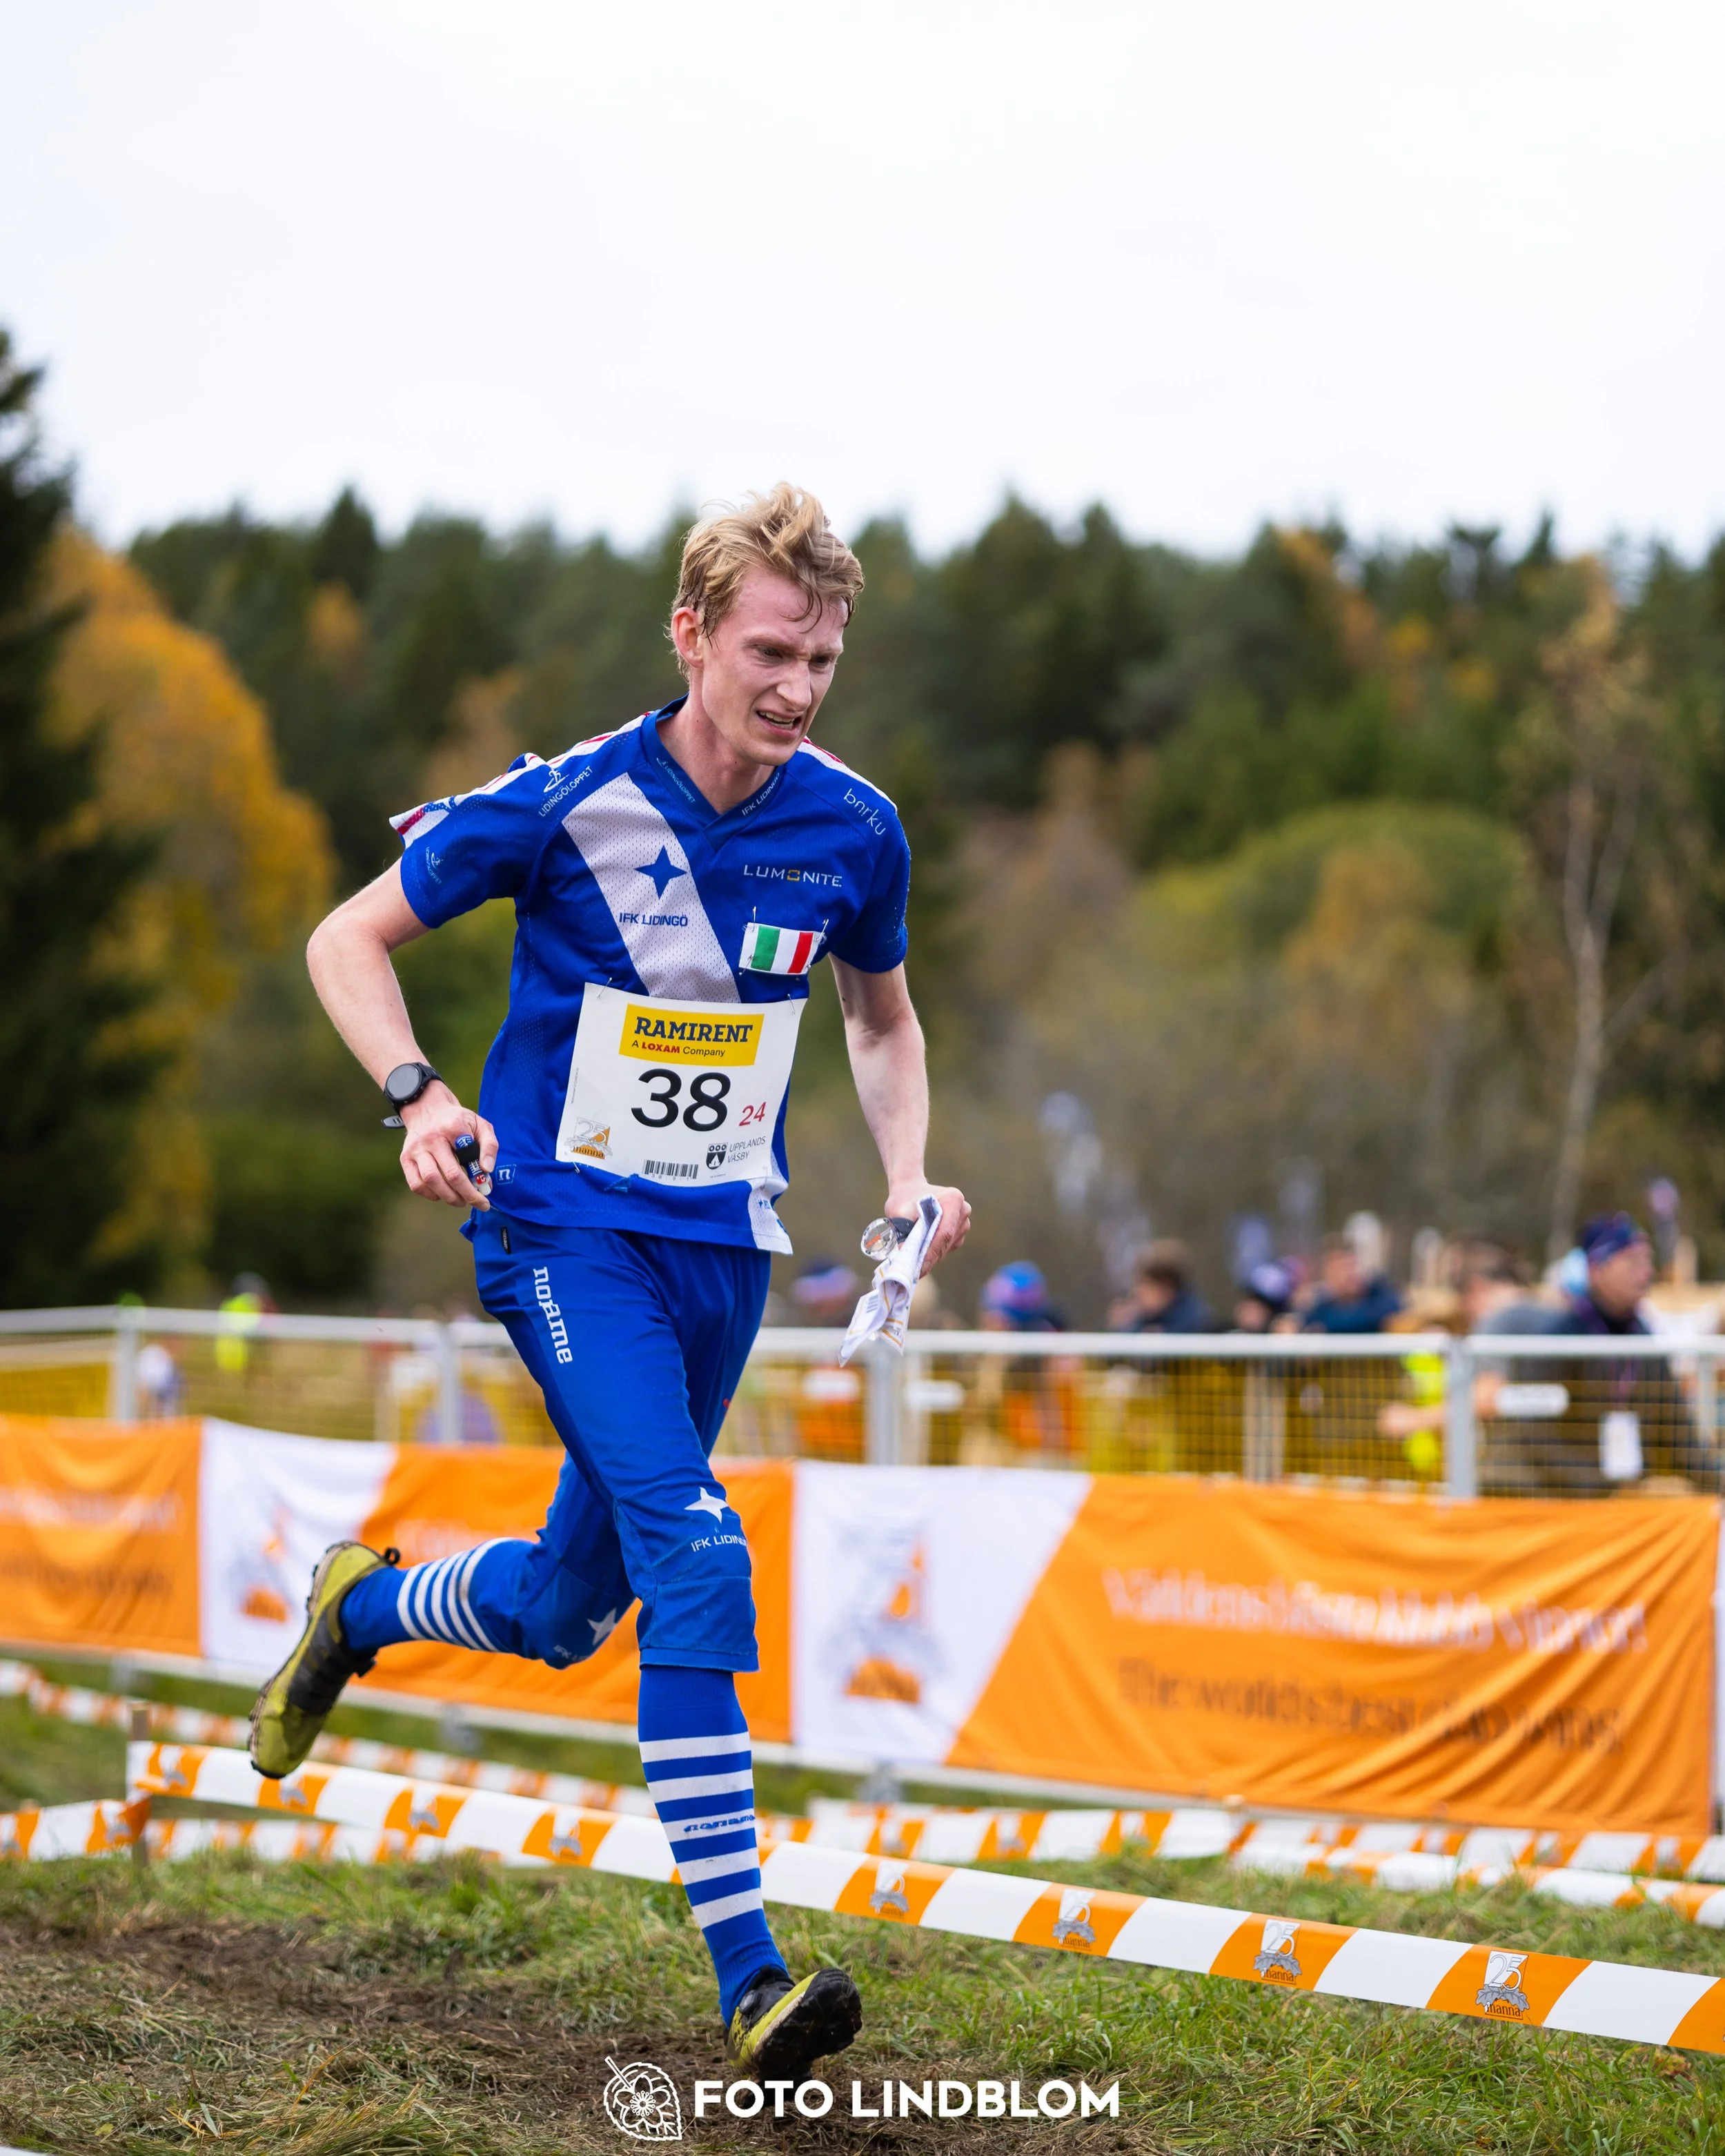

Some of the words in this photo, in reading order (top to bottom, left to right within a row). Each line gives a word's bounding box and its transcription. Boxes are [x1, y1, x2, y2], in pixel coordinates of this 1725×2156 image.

[539, 765, 593, 817] LIDINGÖLOPPET
[741, 802, 756, 816] IFK
[744, 864, 842, 887] LUMONITE
[619, 912, 639, 924] IFK
[641, 914, 689, 927] LIDINGÖ
[634, 1016, 753, 1042] RAMIRENT
[631, 1040, 639, 1048] A
[642, 1042, 680, 1054] LOXAM
[682, 1046, 725, 1057] Company
[631, 1068, 731, 1132] 38
[738, 1101, 767, 1127] 24
[729, 1136, 767, 1153] UPPLANDS
[727, 1151, 751, 1164] VÄSBY
[691, 1537, 711, 1552] IFK
[1265, 1922, 1295, 1957] 25
[1488, 1954, 1522, 1990] 25
